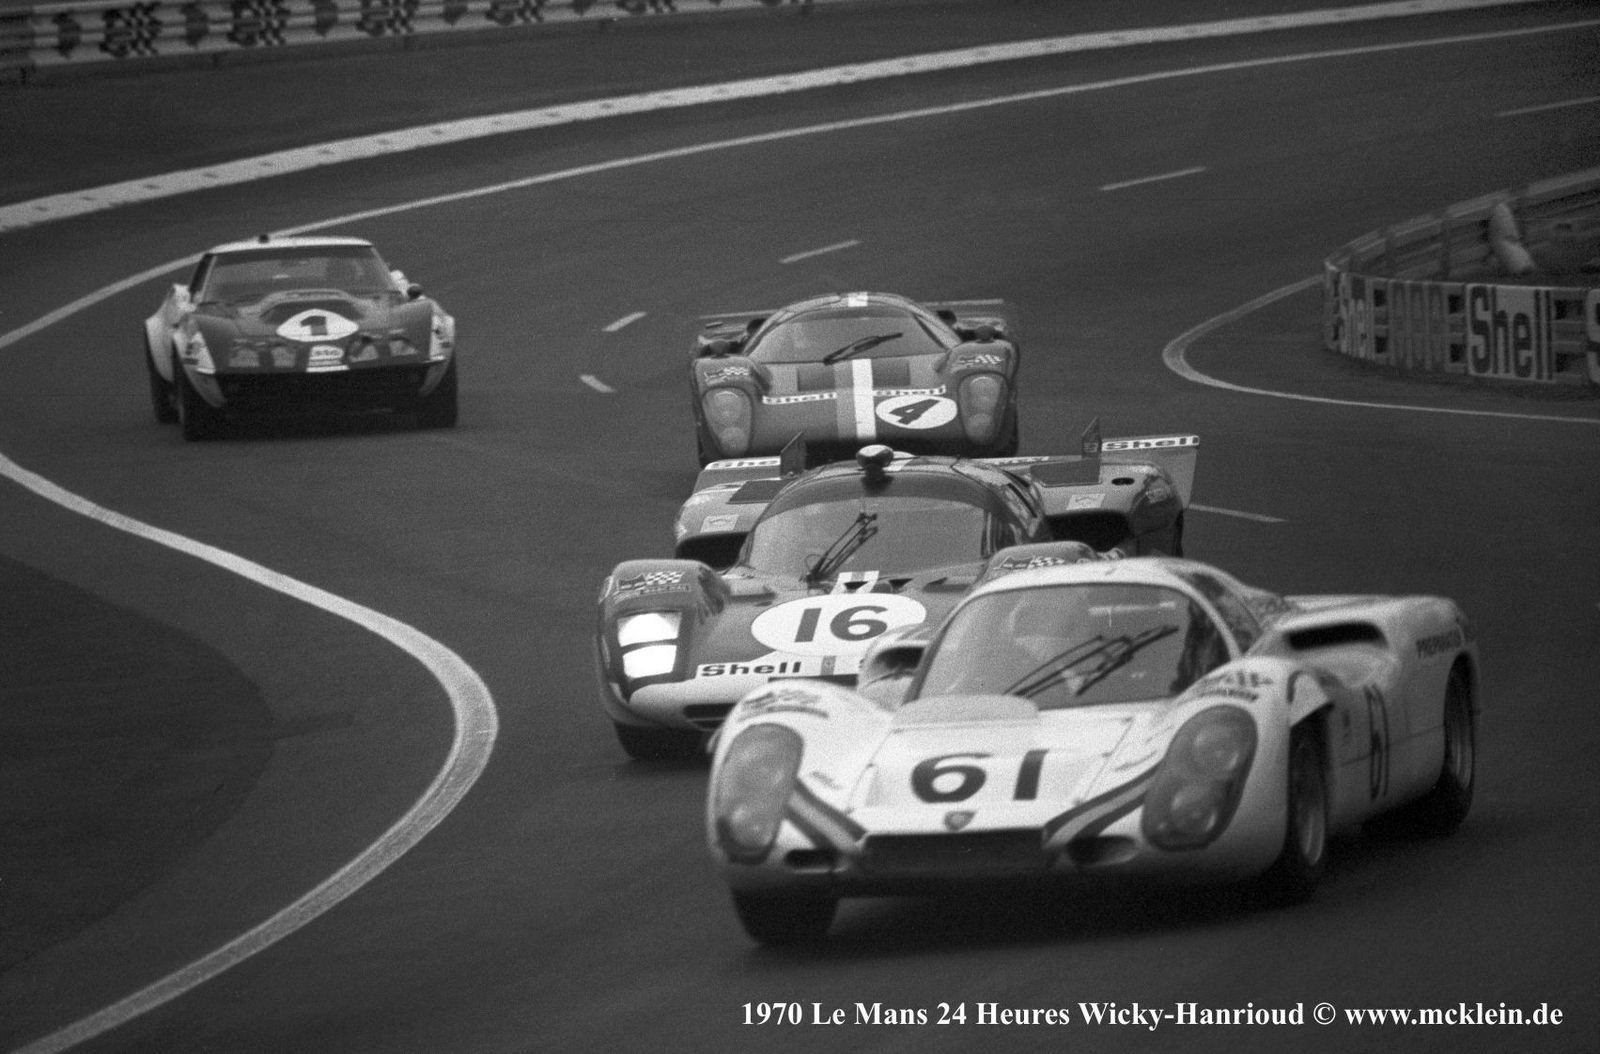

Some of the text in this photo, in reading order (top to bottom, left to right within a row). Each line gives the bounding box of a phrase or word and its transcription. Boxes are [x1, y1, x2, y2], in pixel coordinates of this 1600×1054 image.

[300, 315, 328, 336] 1
[1471, 285, 1553, 381] Shell
[765, 393, 834, 403] Shell
[889, 399, 941, 426] 4
[1104, 436, 1199, 450] Shell
[795, 606, 887, 642] 16
[701, 661, 802, 677] Shell
[911, 749, 1048, 804] 61
